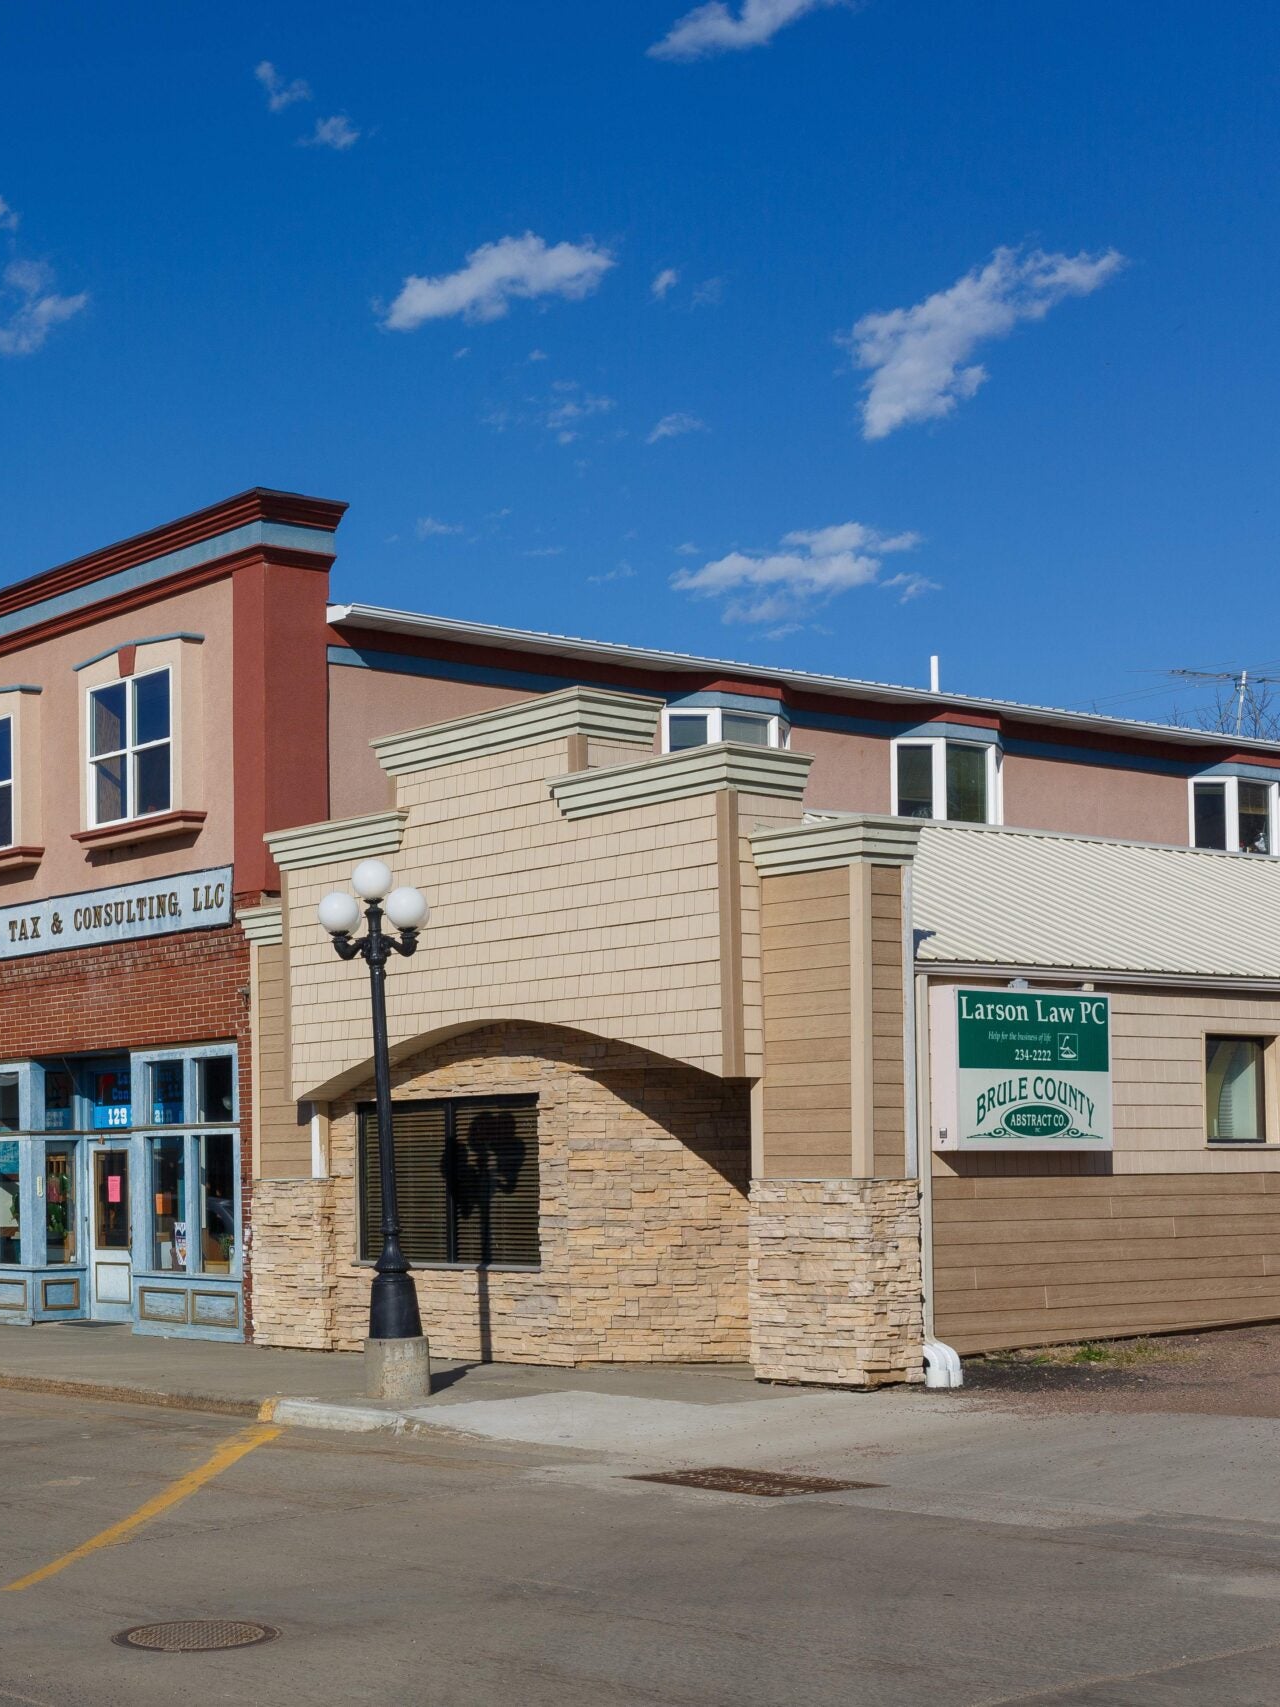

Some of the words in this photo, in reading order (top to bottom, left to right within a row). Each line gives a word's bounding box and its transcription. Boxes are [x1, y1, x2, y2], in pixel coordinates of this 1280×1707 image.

[8, 916, 41, 942] TAX
[51, 911, 63, 935] &
[73, 892, 182, 931] CONSULTING,
[192, 883, 224, 912] LLC
[960, 996, 1029, 1021] Larson
[1035, 999, 1075, 1023] Law
[1080, 1001, 1105, 1025] PC
[988, 1031, 1000, 1043] Help
[1000, 1032, 1009, 1043] for
[1009, 1032, 1017, 1041] the
[1018, 1032, 1037, 1041] business
[1014, 1049, 1052, 1061] 234-2222
[976, 1076, 1028, 1127] BRULE
[1033, 1076, 1095, 1128] COUNTY
[108, 1107, 127, 1125] 129
[1010, 1114, 1052, 1127] ABSTRACT
[1053, 1114, 1067, 1127] CO.
